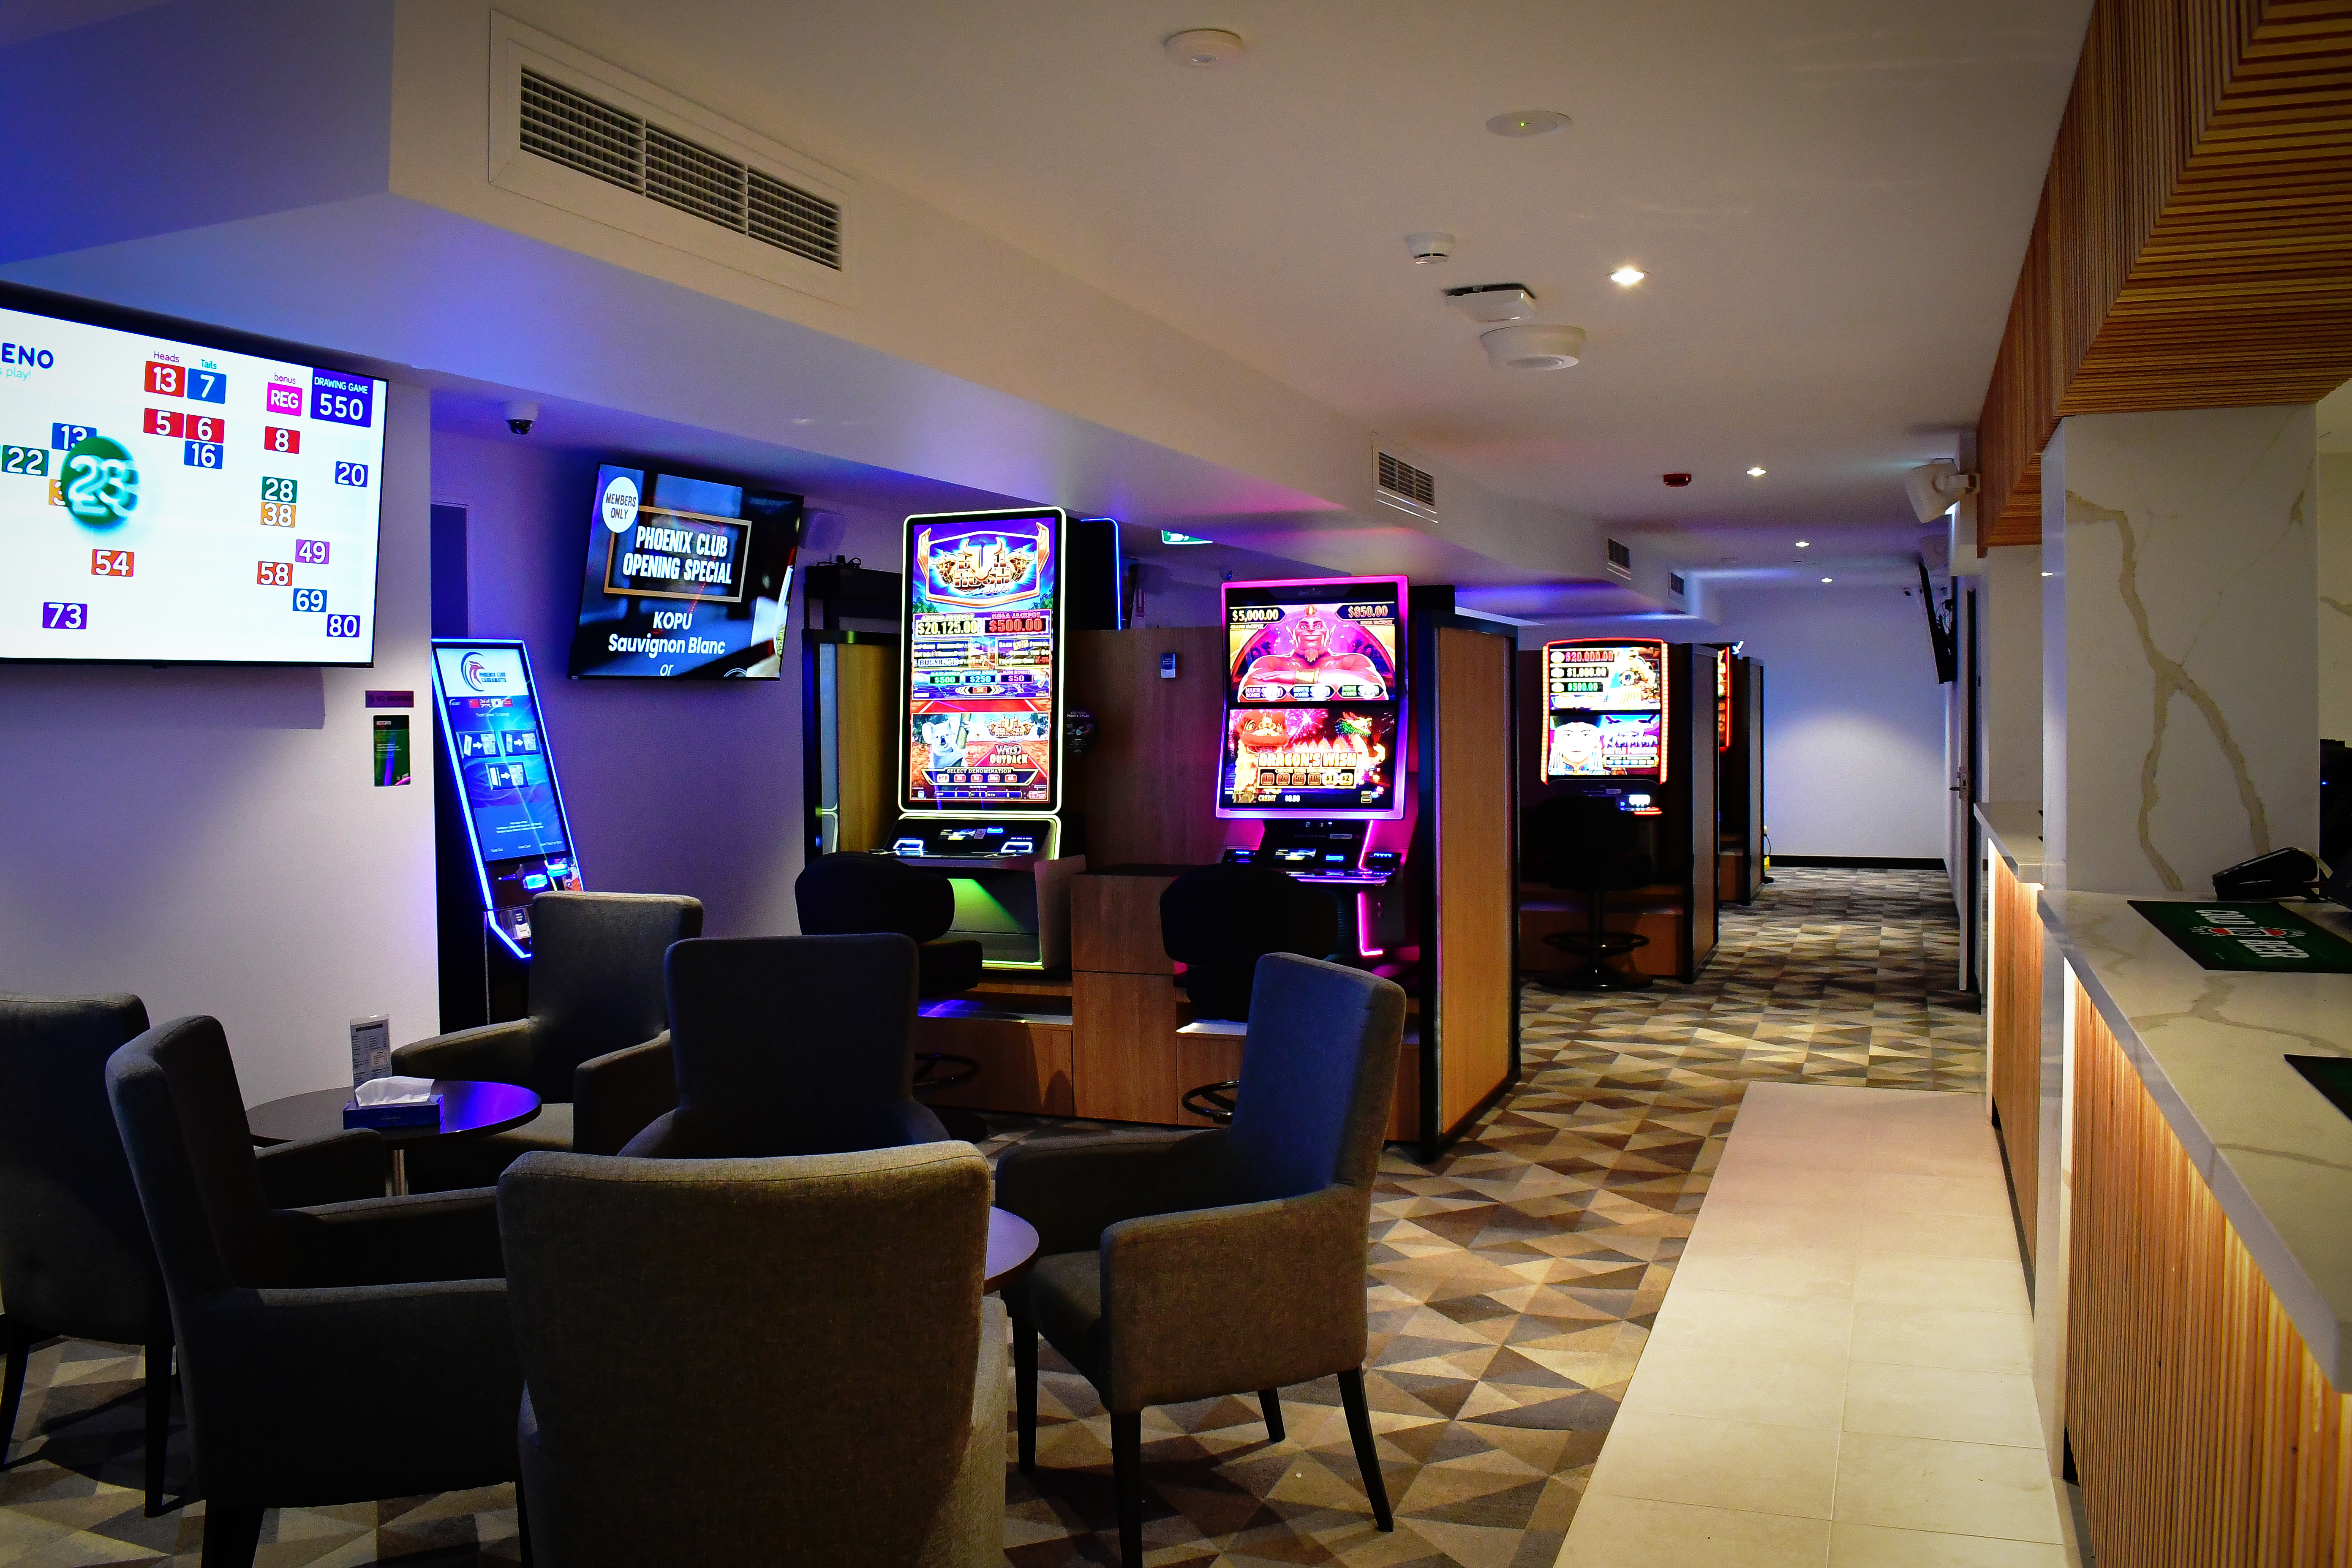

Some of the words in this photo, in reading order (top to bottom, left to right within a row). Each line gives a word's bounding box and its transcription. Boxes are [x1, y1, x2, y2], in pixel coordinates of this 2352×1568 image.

[154, 351, 180, 363] Heads
[201, 359, 217, 370] Tails
[6, 367, 31, 381] play!
[154, 367, 177, 392] 13
[274, 372, 296, 384] bonus
[201, 375, 215, 398] 7
[314, 376, 347, 391] DRAWING
[348, 382, 368, 394] GAME
[270, 389, 299, 409] REG
[320, 394, 363, 420] 550
[156, 413, 171, 436] 5
[198, 419, 212, 441] 6
[275, 430, 289, 452] 8
[7, 449, 43, 474] 22
[192, 443, 216, 467] 16
[338, 464, 365, 485] 20
[265, 479, 294, 501] 28
[605, 493, 636, 507] MEMBERS
[263, 504, 292, 525] 38
[610, 508, 629, 520] ONLY
[635, 525, 694, 553] PHOENIX
[697, 533, 728, 557] CLUB
[299, 542, 326, 562] 49
[95, 552, 130, 575] 54
[623, 553, 681, 580] OPENING
[683, 559, 732, 584] SPECIAL
[260, 564, 289, 584] 58
[295, 590, 323, 610] 69
[48, 604, 82, 629] 73
[653, 611, 693, 630] KOPU
[1232, 609, 1279, 622] $5,000.00
[1348, 605, 1388, 618] $850.00
[329, 616, 357, 637] 80
[918, 621, 978, 636] $20,125.00
[989, 618, 1043, 632] $500.00
[608, 633, 686, 659] Sauvignon
[688, 637, 726, 655] Blanc
[660, 664, 674, 676] or
[1568, 682, 1598, 691] $500.00
[989, 753, 1029, 765] OUTBACK
[994, 744, 1022, 755] WILD
[1258, 752, 1321, 767] DRAGON'S
[1322, 752, 1357, 767] WISH
[2195, 910, 2256, 925] COLD
[2236, 939, 2310, 958] BEER
